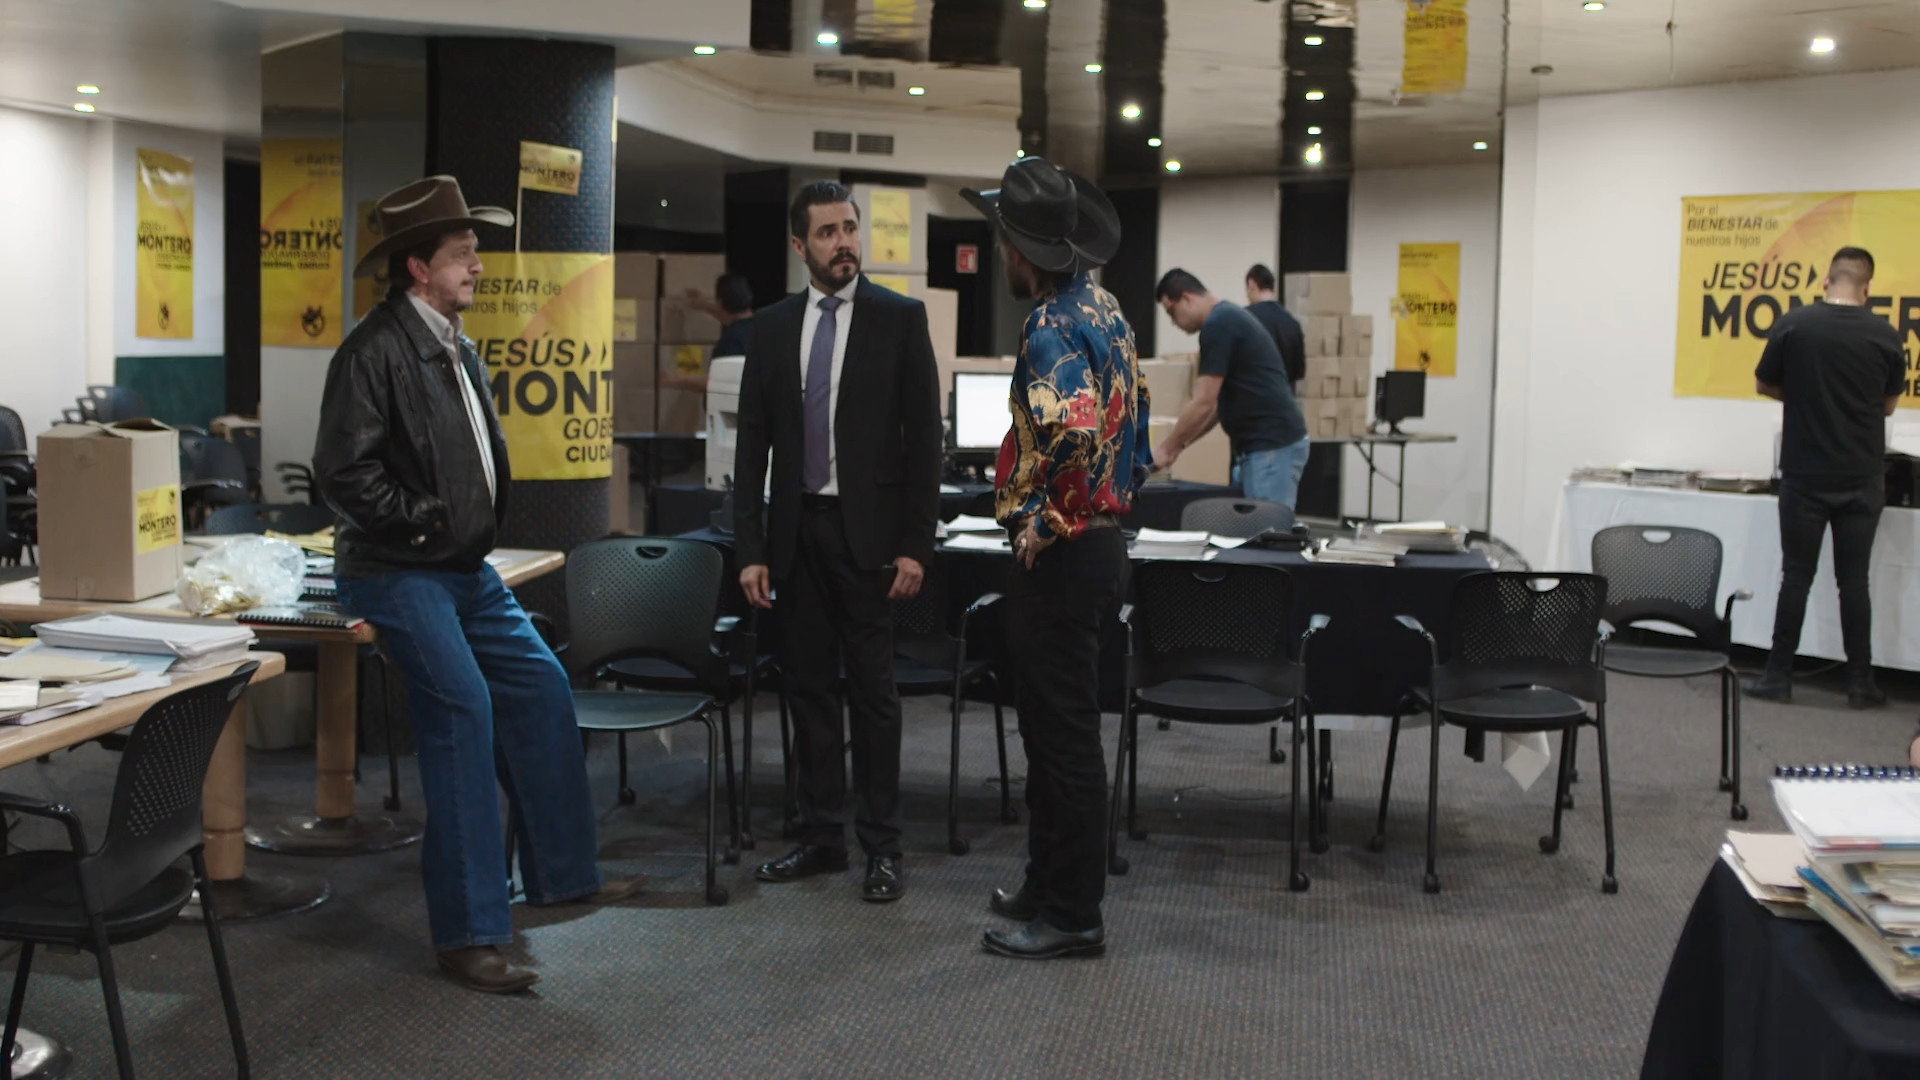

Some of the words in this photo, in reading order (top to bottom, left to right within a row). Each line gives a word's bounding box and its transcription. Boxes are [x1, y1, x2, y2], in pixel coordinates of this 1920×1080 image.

[1687, 216, 1763, 231] BIENESTAR
[1764, 219, 1778, 231] de
[138, 234, 192, 254] MONTERO
[1686, 235, 1731, 247] nuestros
[1735, 235, 1760, 248] hijos
[1703, 254, 1801, 291] JESÚS
[473, 278, 539, 295] ESTAR
[542, 281, 563, 296] de
[502, 299, 538, 318] hijos
[1404, 300, 1457, 316] ONTERO
[565, 445, 613, 463] CIUD
[138, 514, 177, 534] MONTERO
